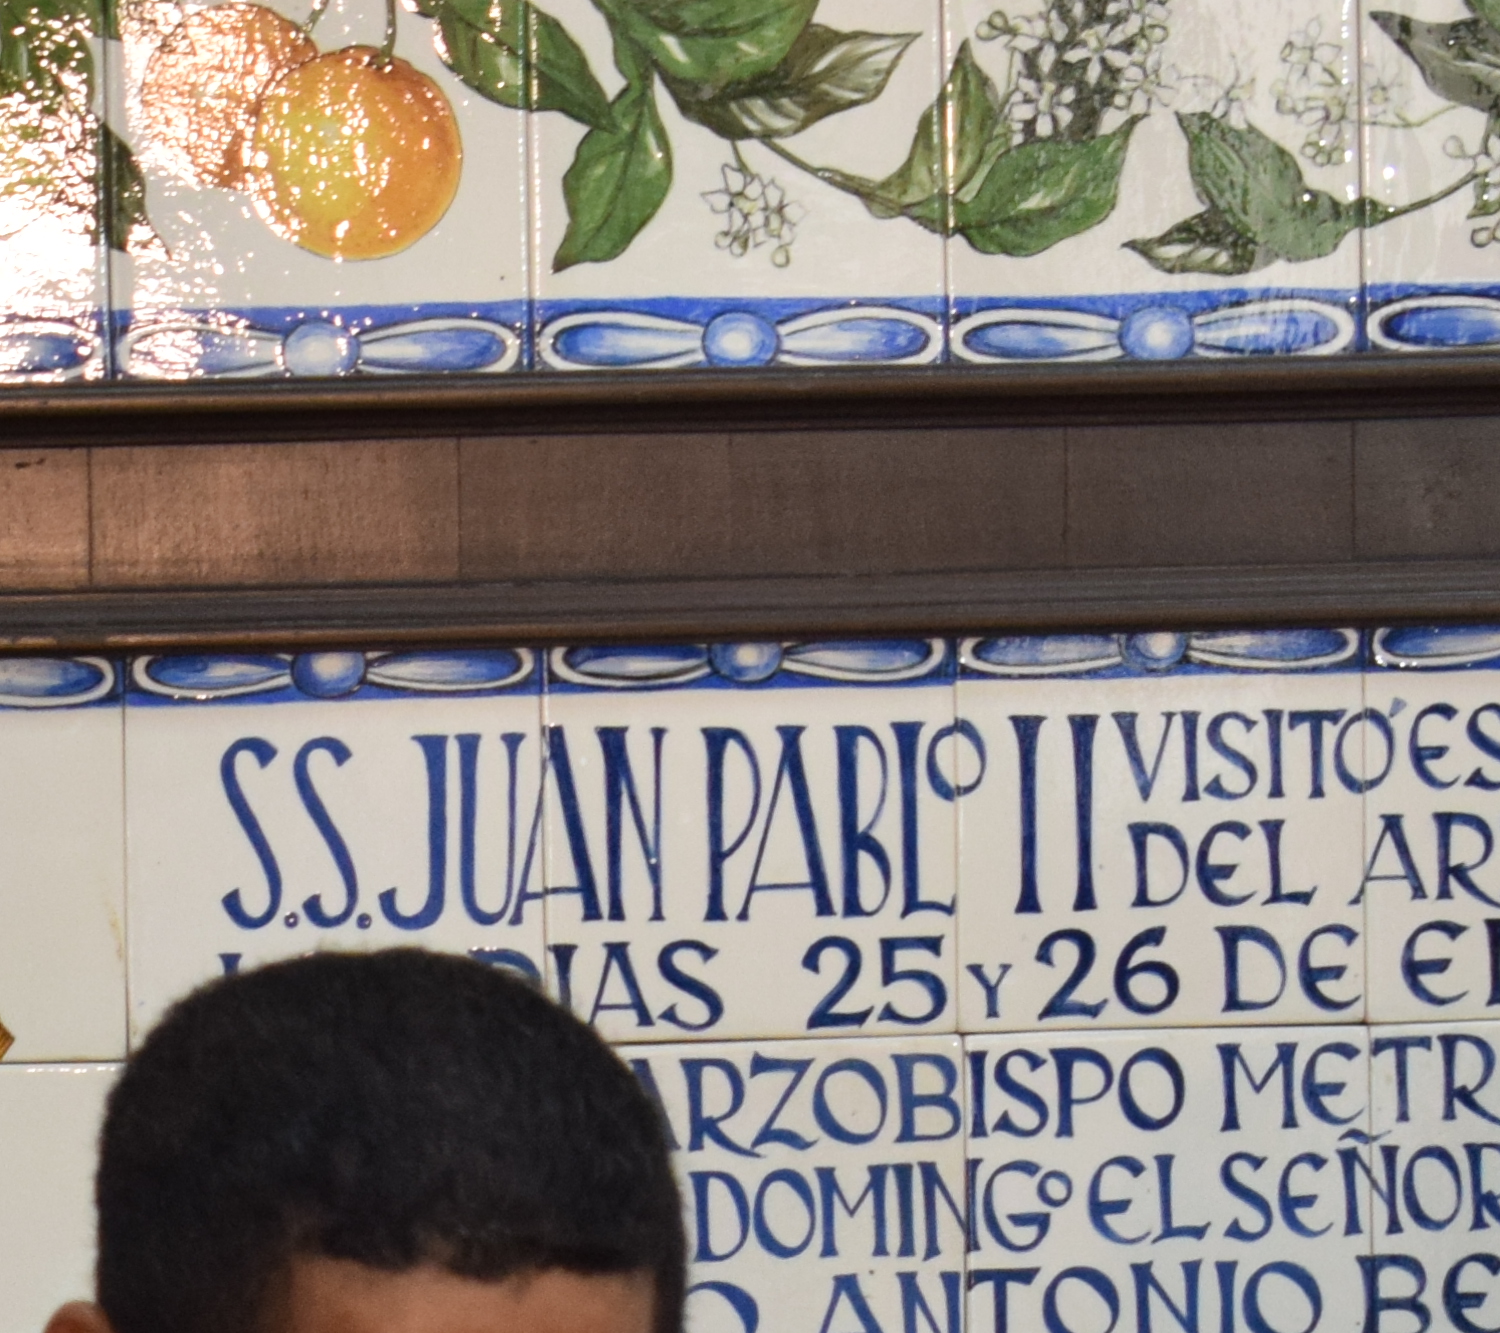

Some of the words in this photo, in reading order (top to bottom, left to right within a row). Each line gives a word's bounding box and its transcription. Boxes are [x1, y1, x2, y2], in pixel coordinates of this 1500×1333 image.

[378, 725, 668, 930] JUAN
[1007, 712, 1103, 915] II
[1127, 818, 1317, 909] DEL
[468, 939, 724, 1031] IAS
[800, 933, 950, 1032] 25
[1033, 925, 1180, 1021] 26
[1215, 922, 1362, 1013] DE
[1088, 1153, 1224, 1245] EL
